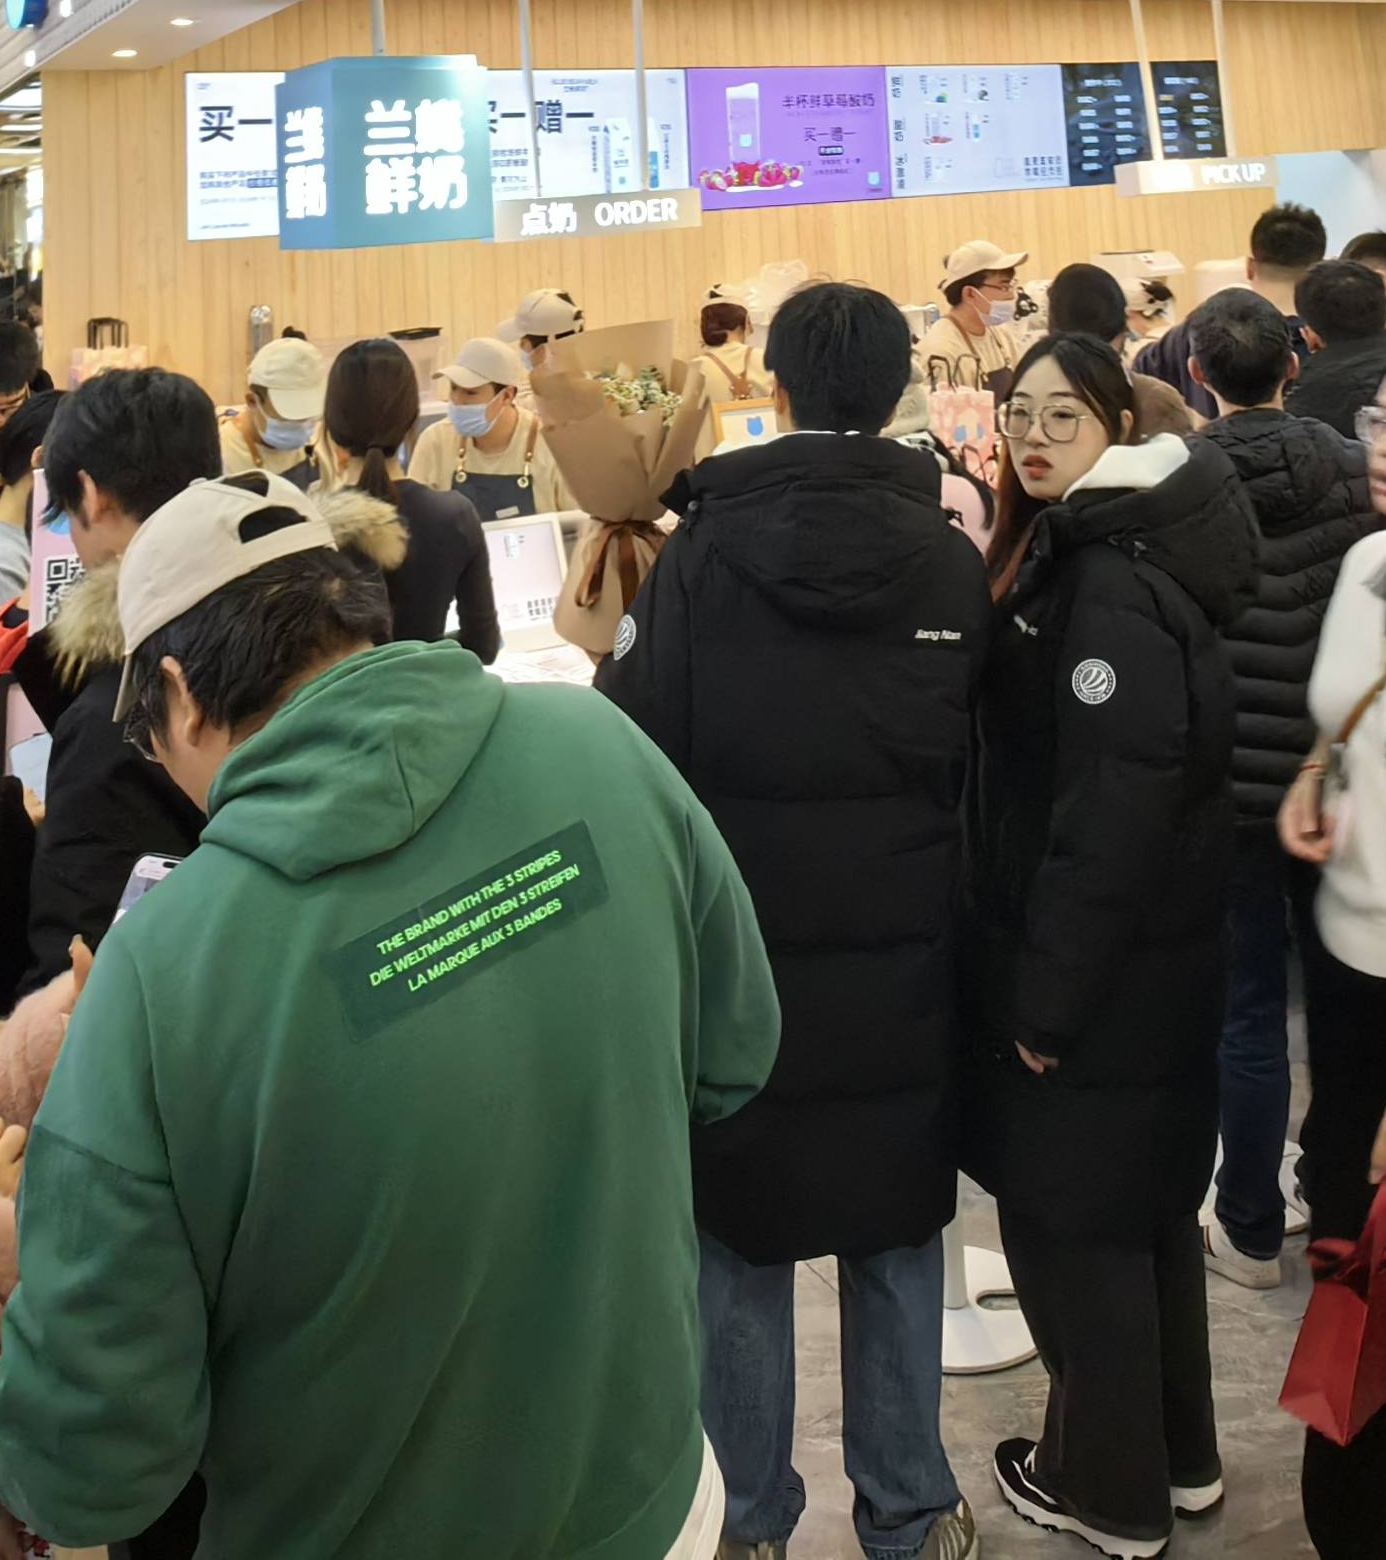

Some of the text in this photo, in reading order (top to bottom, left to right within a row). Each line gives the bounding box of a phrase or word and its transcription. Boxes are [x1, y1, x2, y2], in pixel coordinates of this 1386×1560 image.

[365, 155, 468, 214] 鲜奶
[1201, 166, 1241, 184] PICK
[1241, 163, 1267, 182] UP
[521, 198, 678, 236] 点奶 ORDER
[369, 863, 580, 987] DIE WELTMARKE MIT DEN 3 STREIFEN
[376, 850, 562, 955] THE BRAND WITH THE 3 STRIPES
[408, 898, 562, 992] LA MARQUE AUX 3 BANDES
